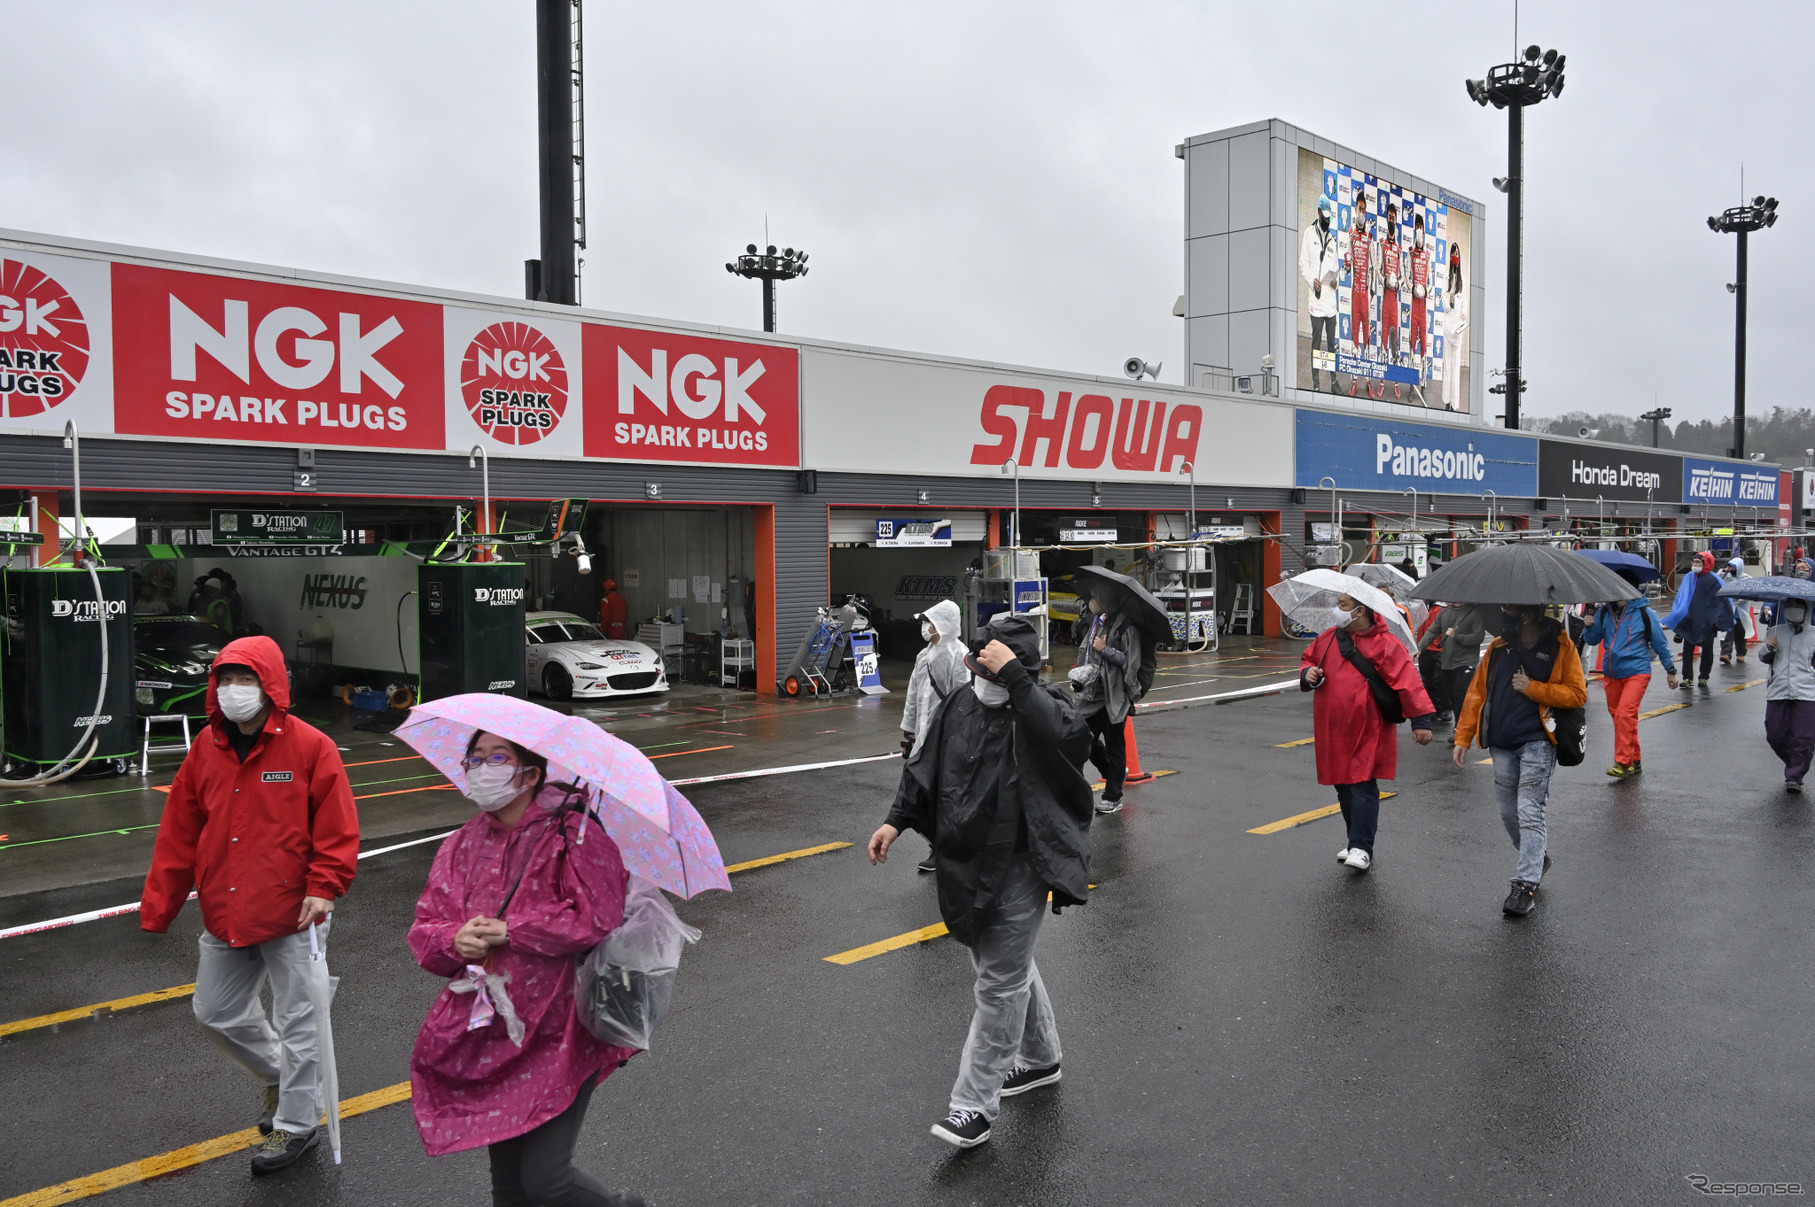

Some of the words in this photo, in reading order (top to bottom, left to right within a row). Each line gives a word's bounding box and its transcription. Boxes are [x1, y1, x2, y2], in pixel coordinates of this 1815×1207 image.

[1438, 188, 1473, 213] Panasonic
[0, 295, 61, 338] GK
[169, 293, 405, 400] NGK
[0, 349, 62, 371] ARK
[478, 347, 551, 383] NGK
[0, 374, 62, 396] UGS
[617, 345, 767, 426] NGK
[480, 389, 551, 410] SPARK
[165, 391, 288, 425] SPARK
[298, 400, 407, 431] PLUGS
[481, 408, 552, 429] PLUGS
[614, 422, 691, 448] SPARK
[698, 428, 768, 451] PLUGS
[970, 385, 1203, 474] SHOWA
[1376, 433, 1485, 482] Panasonic
[300, 473, 310, 487] 2
[1572, 459, 1617, 486] Honda
[1620, 464, 1660, 488] Dream
[650, 485, 658, 496] 3
[920, 492, 928, 502] 4
[1689, 476, 1733, 498] KEIHIN
[1739, 480, 1776, 500] KEIHIN
[252, 514, 307, 527] D'STATION
[313, 514, 336, 533] 47
[880, 523, 891, 534] 225
[300, 573, 369, 610] NEXUS
[475, 588, 523, 601] D'STATION
[895, 575, 958, 596] KTMS
[52, 599, 127, 617] D'STAION
[860, 661, 873, 674] 225
[98, 910, 117, 919] TWIN
